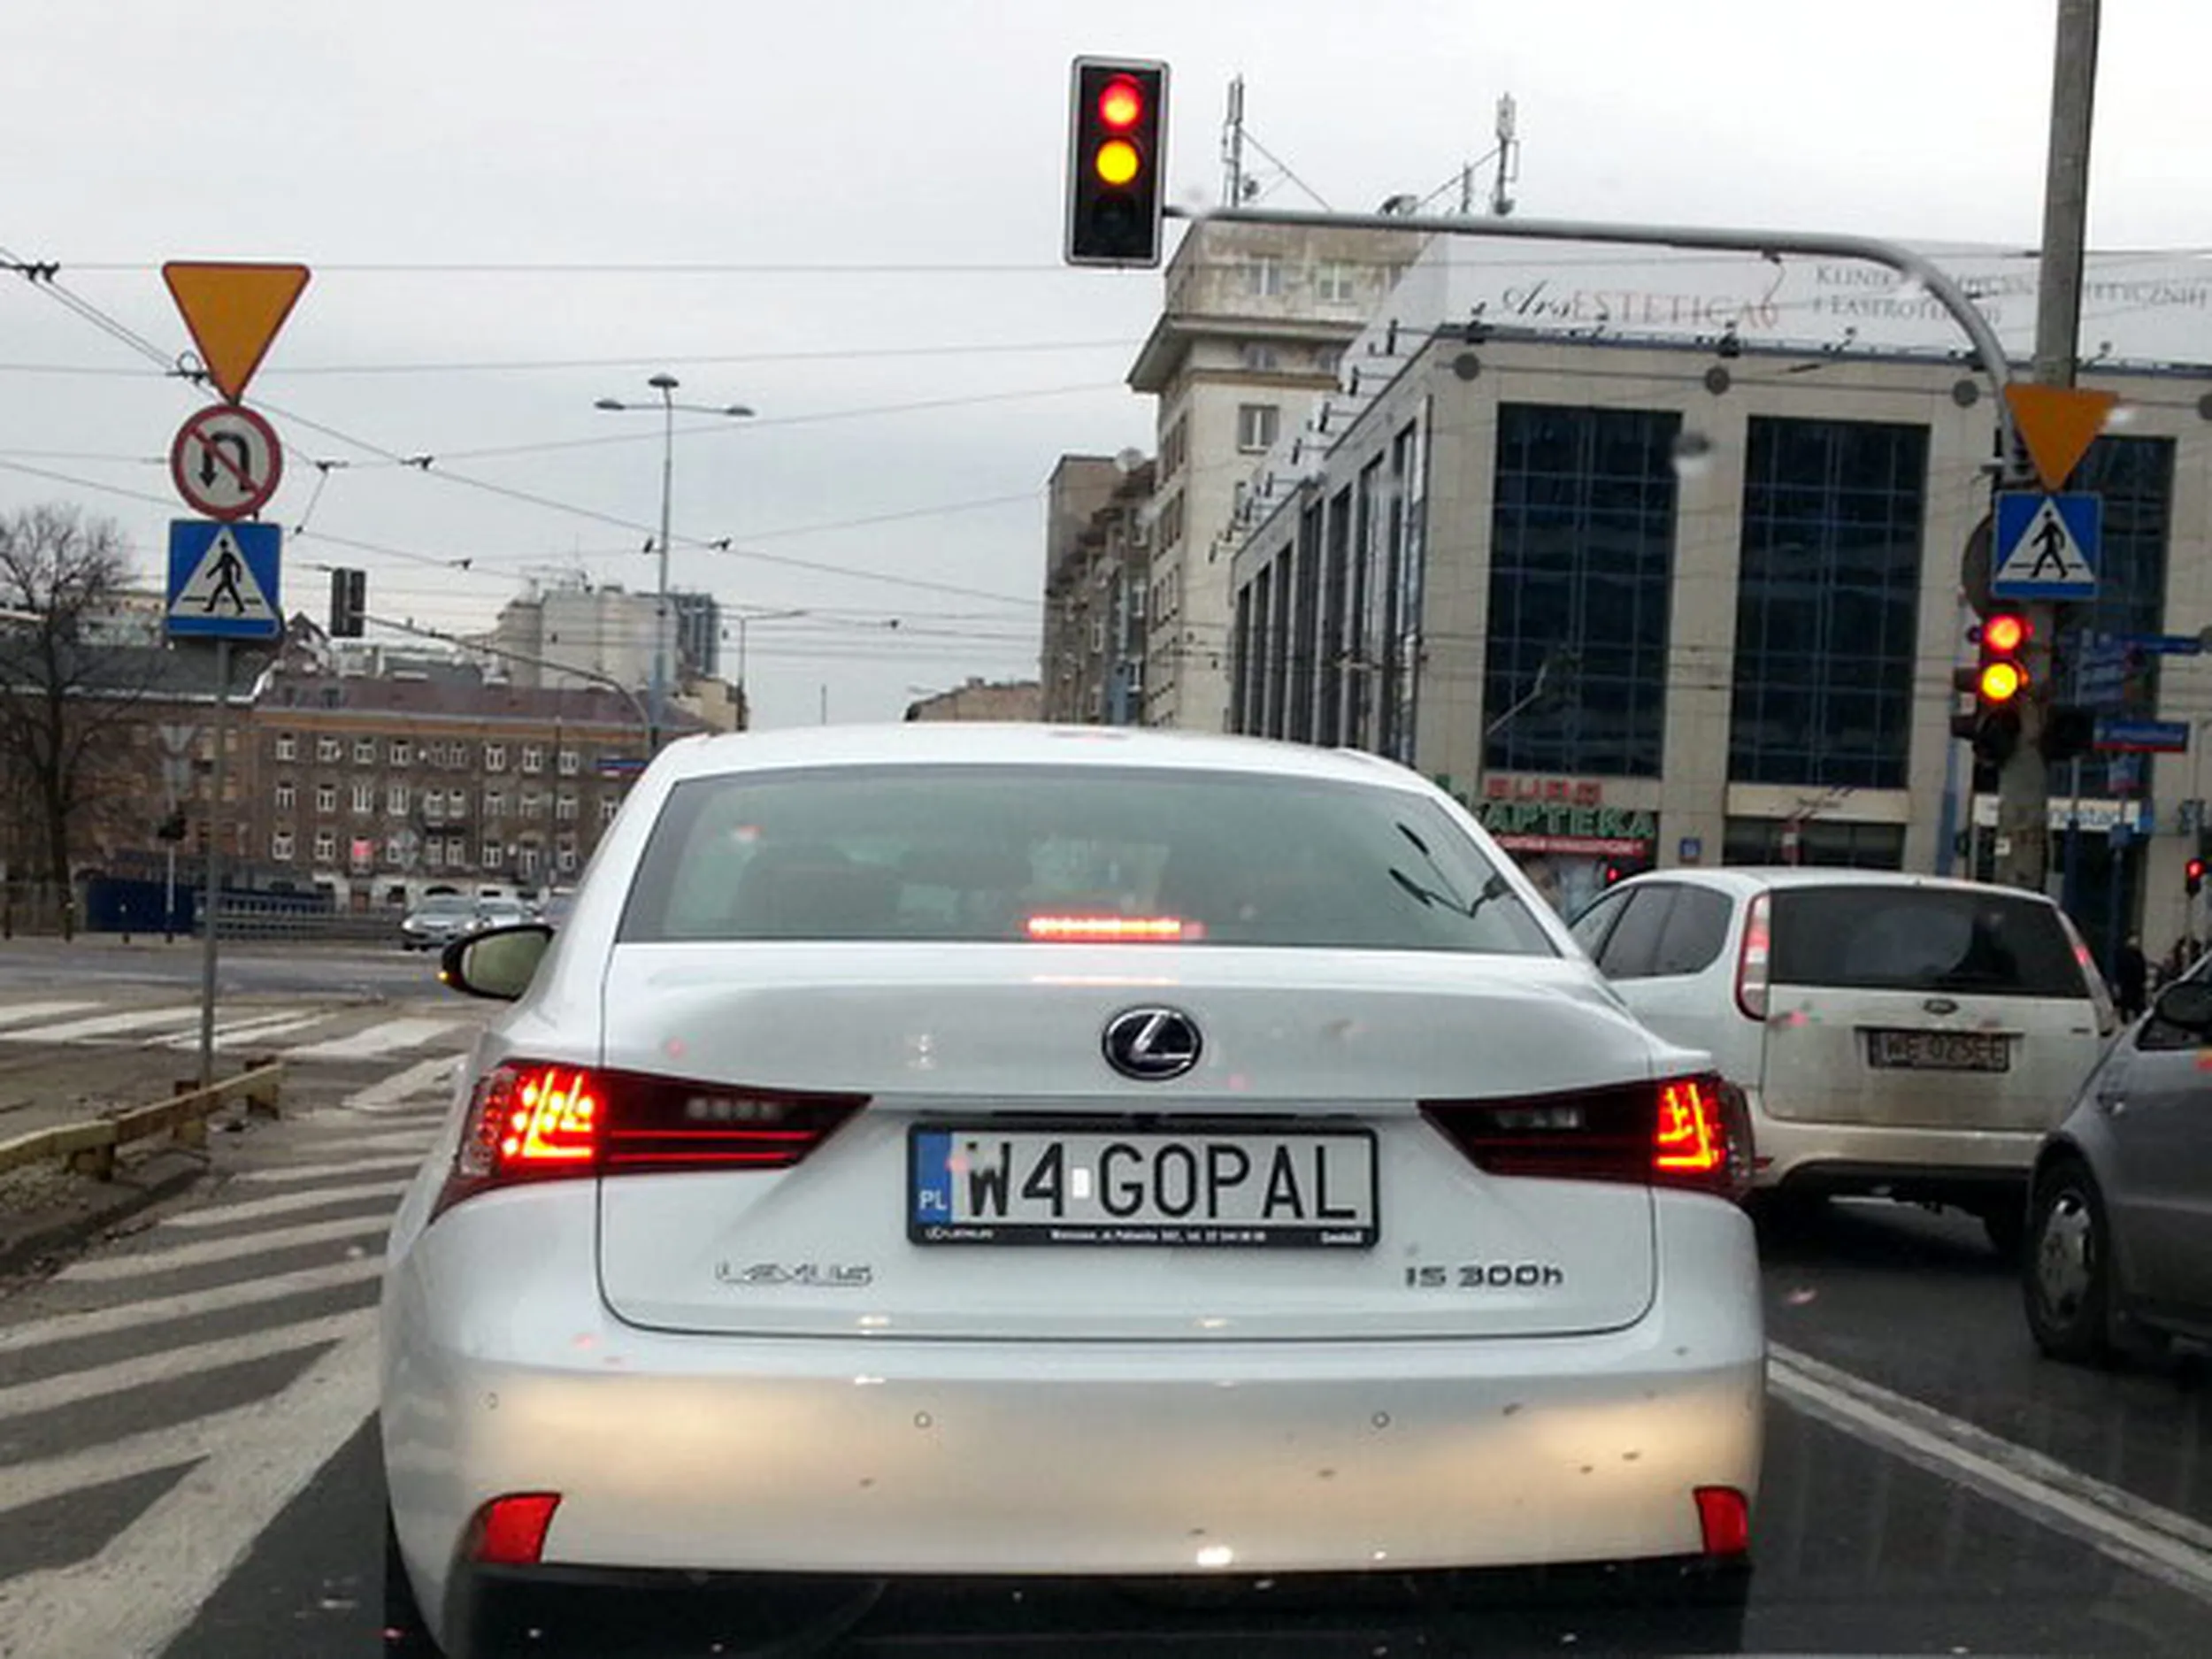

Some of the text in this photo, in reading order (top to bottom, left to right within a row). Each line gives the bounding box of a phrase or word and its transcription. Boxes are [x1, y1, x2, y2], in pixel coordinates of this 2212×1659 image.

[1483, 803, 1655, 839] APTEKA
[965, 1141, 1356, 1219] W4 GOPAL
[919, 1189, 947, 1210] PL
[1406, 1264, 1564, 1287] IS 300h
